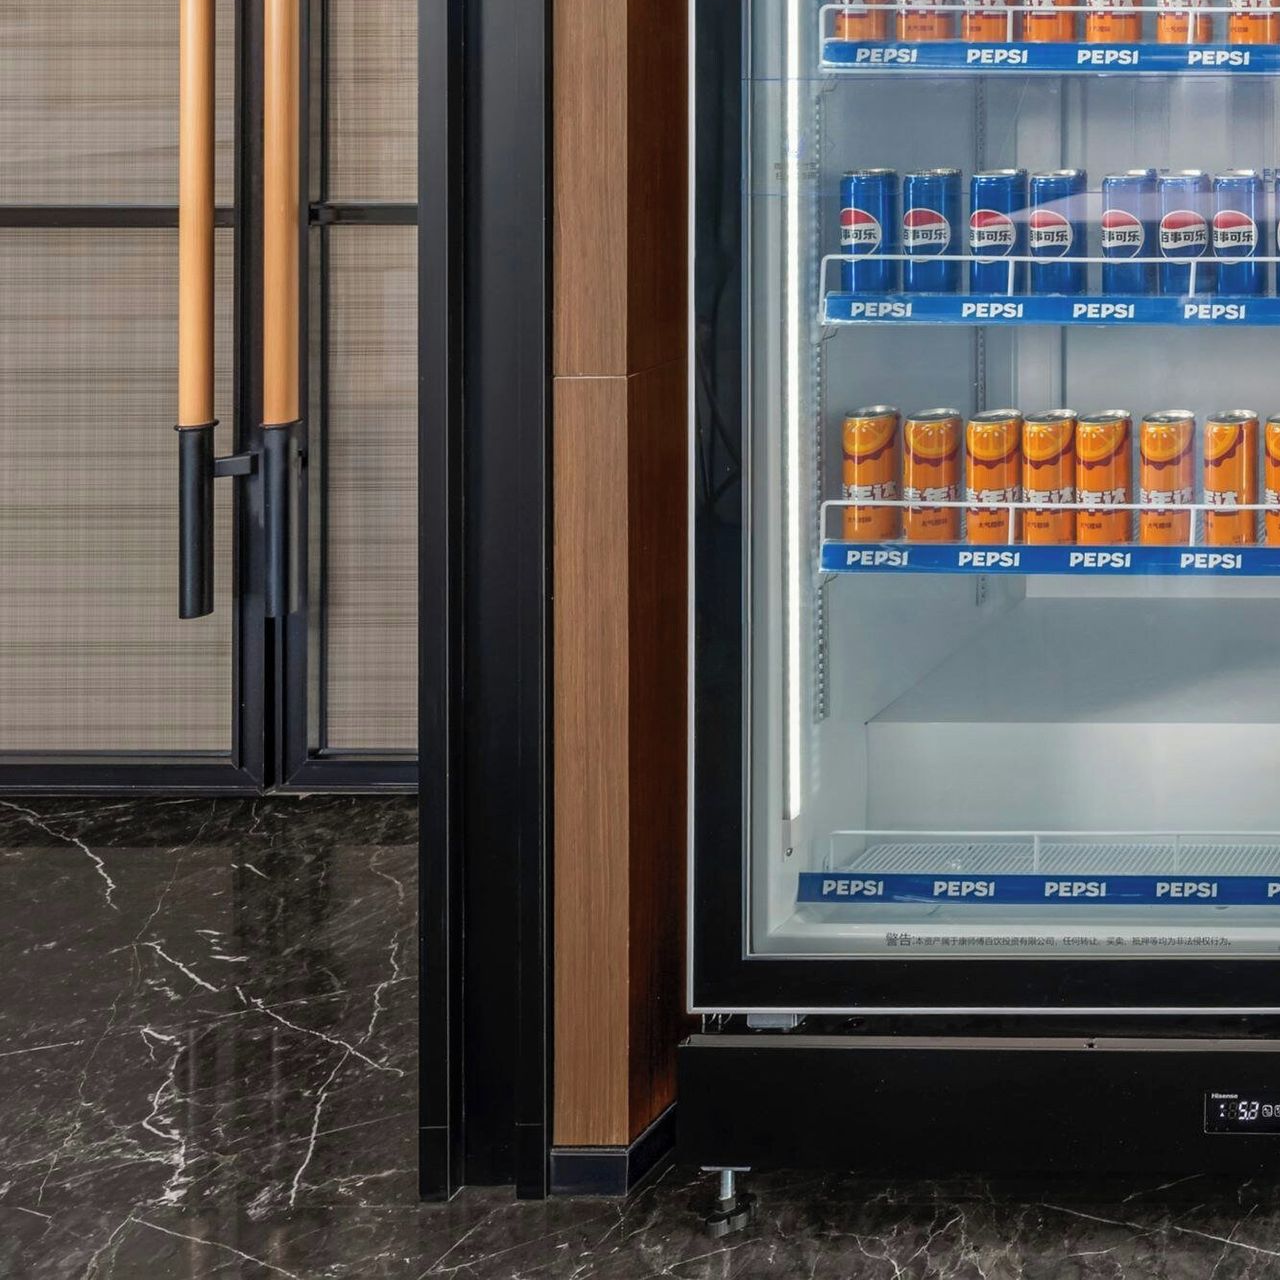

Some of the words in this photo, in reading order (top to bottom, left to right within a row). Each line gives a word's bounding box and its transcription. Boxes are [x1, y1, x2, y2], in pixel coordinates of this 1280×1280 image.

[856, 49, 917, 62] PEPSI
[967, 49, 1028, 63] PEPSI
[1078, 50, 1139, 64] PEPSI
[1188, 51, 1250, 65] PEPSI
[1161, 230, 1207, 244] 百事可乐
[851, 303, 912, 317] PEPSI
[962, 304, 1023, 317] PEPSI
[1073, 304, 1135, 318] PEPSI
[1184, 305, 1245, 319] PEPSI
[847, 551, 908, 565] PEPSI
[959, 552, 1020, 566] PEPSI
[1070, 552, 1131, 567] PEPSI
[1181, 554, 1242, 568] PEPSI
[823, 880, 883, 895] PEPSI
[933, 881, 995, 896] PEPSI
[1045, 882, 1106, 897] PEPSI
[1156, 883, 1217, 897] PEPSI
